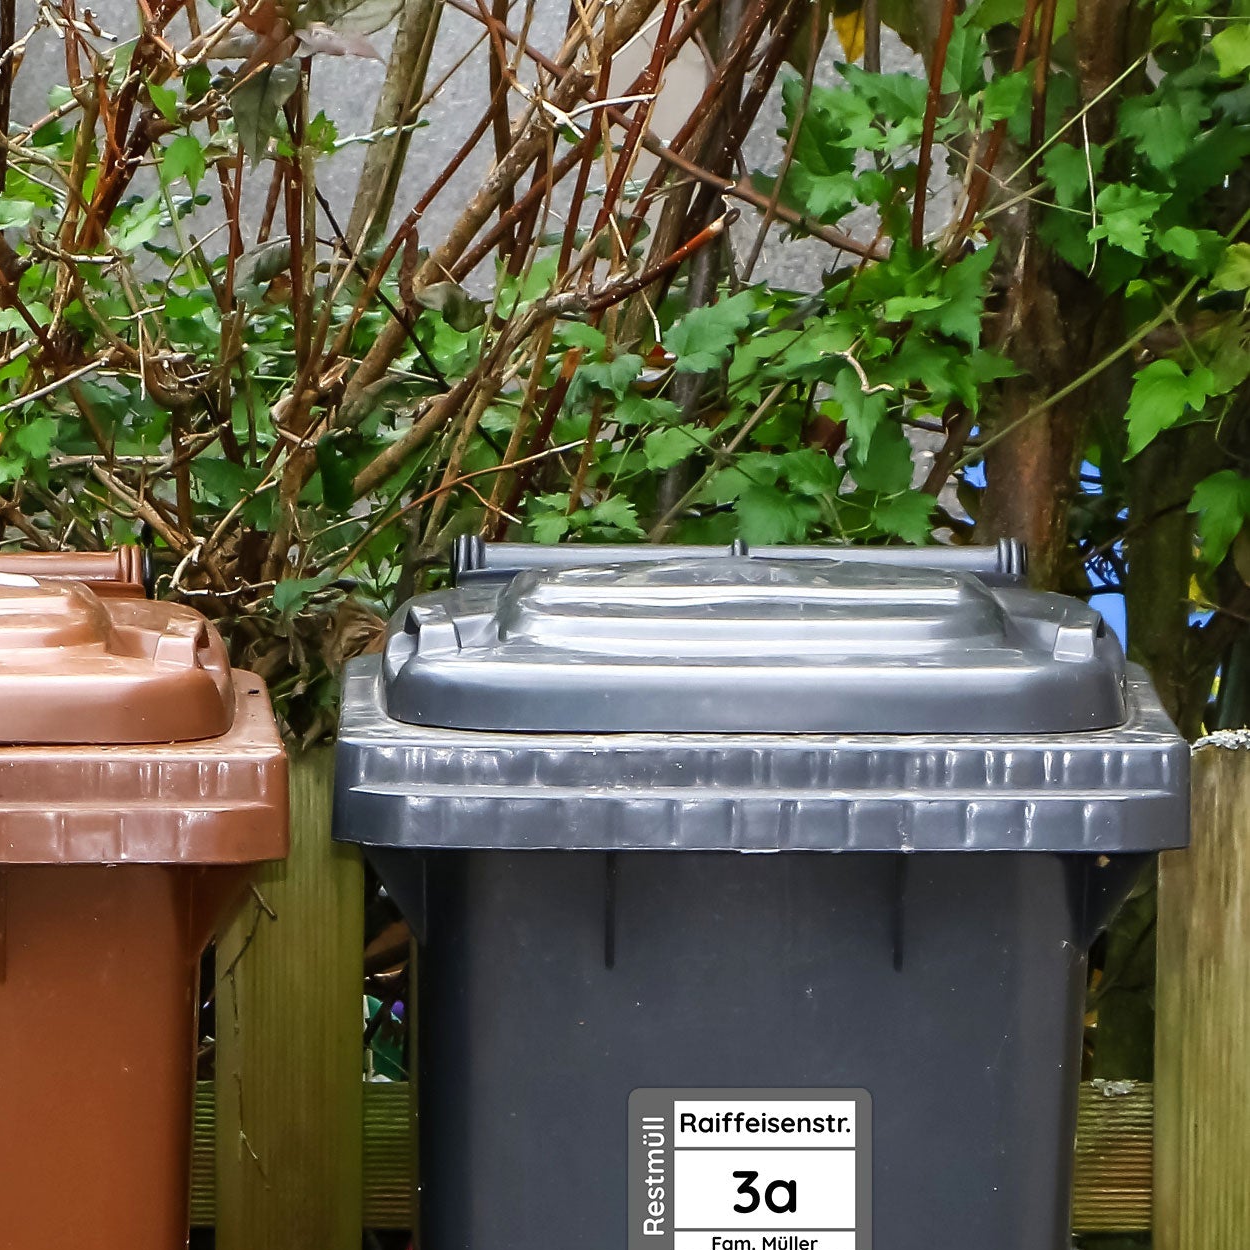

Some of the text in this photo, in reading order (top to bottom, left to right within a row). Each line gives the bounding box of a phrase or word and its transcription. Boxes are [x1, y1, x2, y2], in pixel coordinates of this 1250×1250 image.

[680, 1111, 851, 1134] Raiffeisenstr.
[641, 1117, 665, 1236] Restmüll
[732, 1170, 797, 1214] 3a
